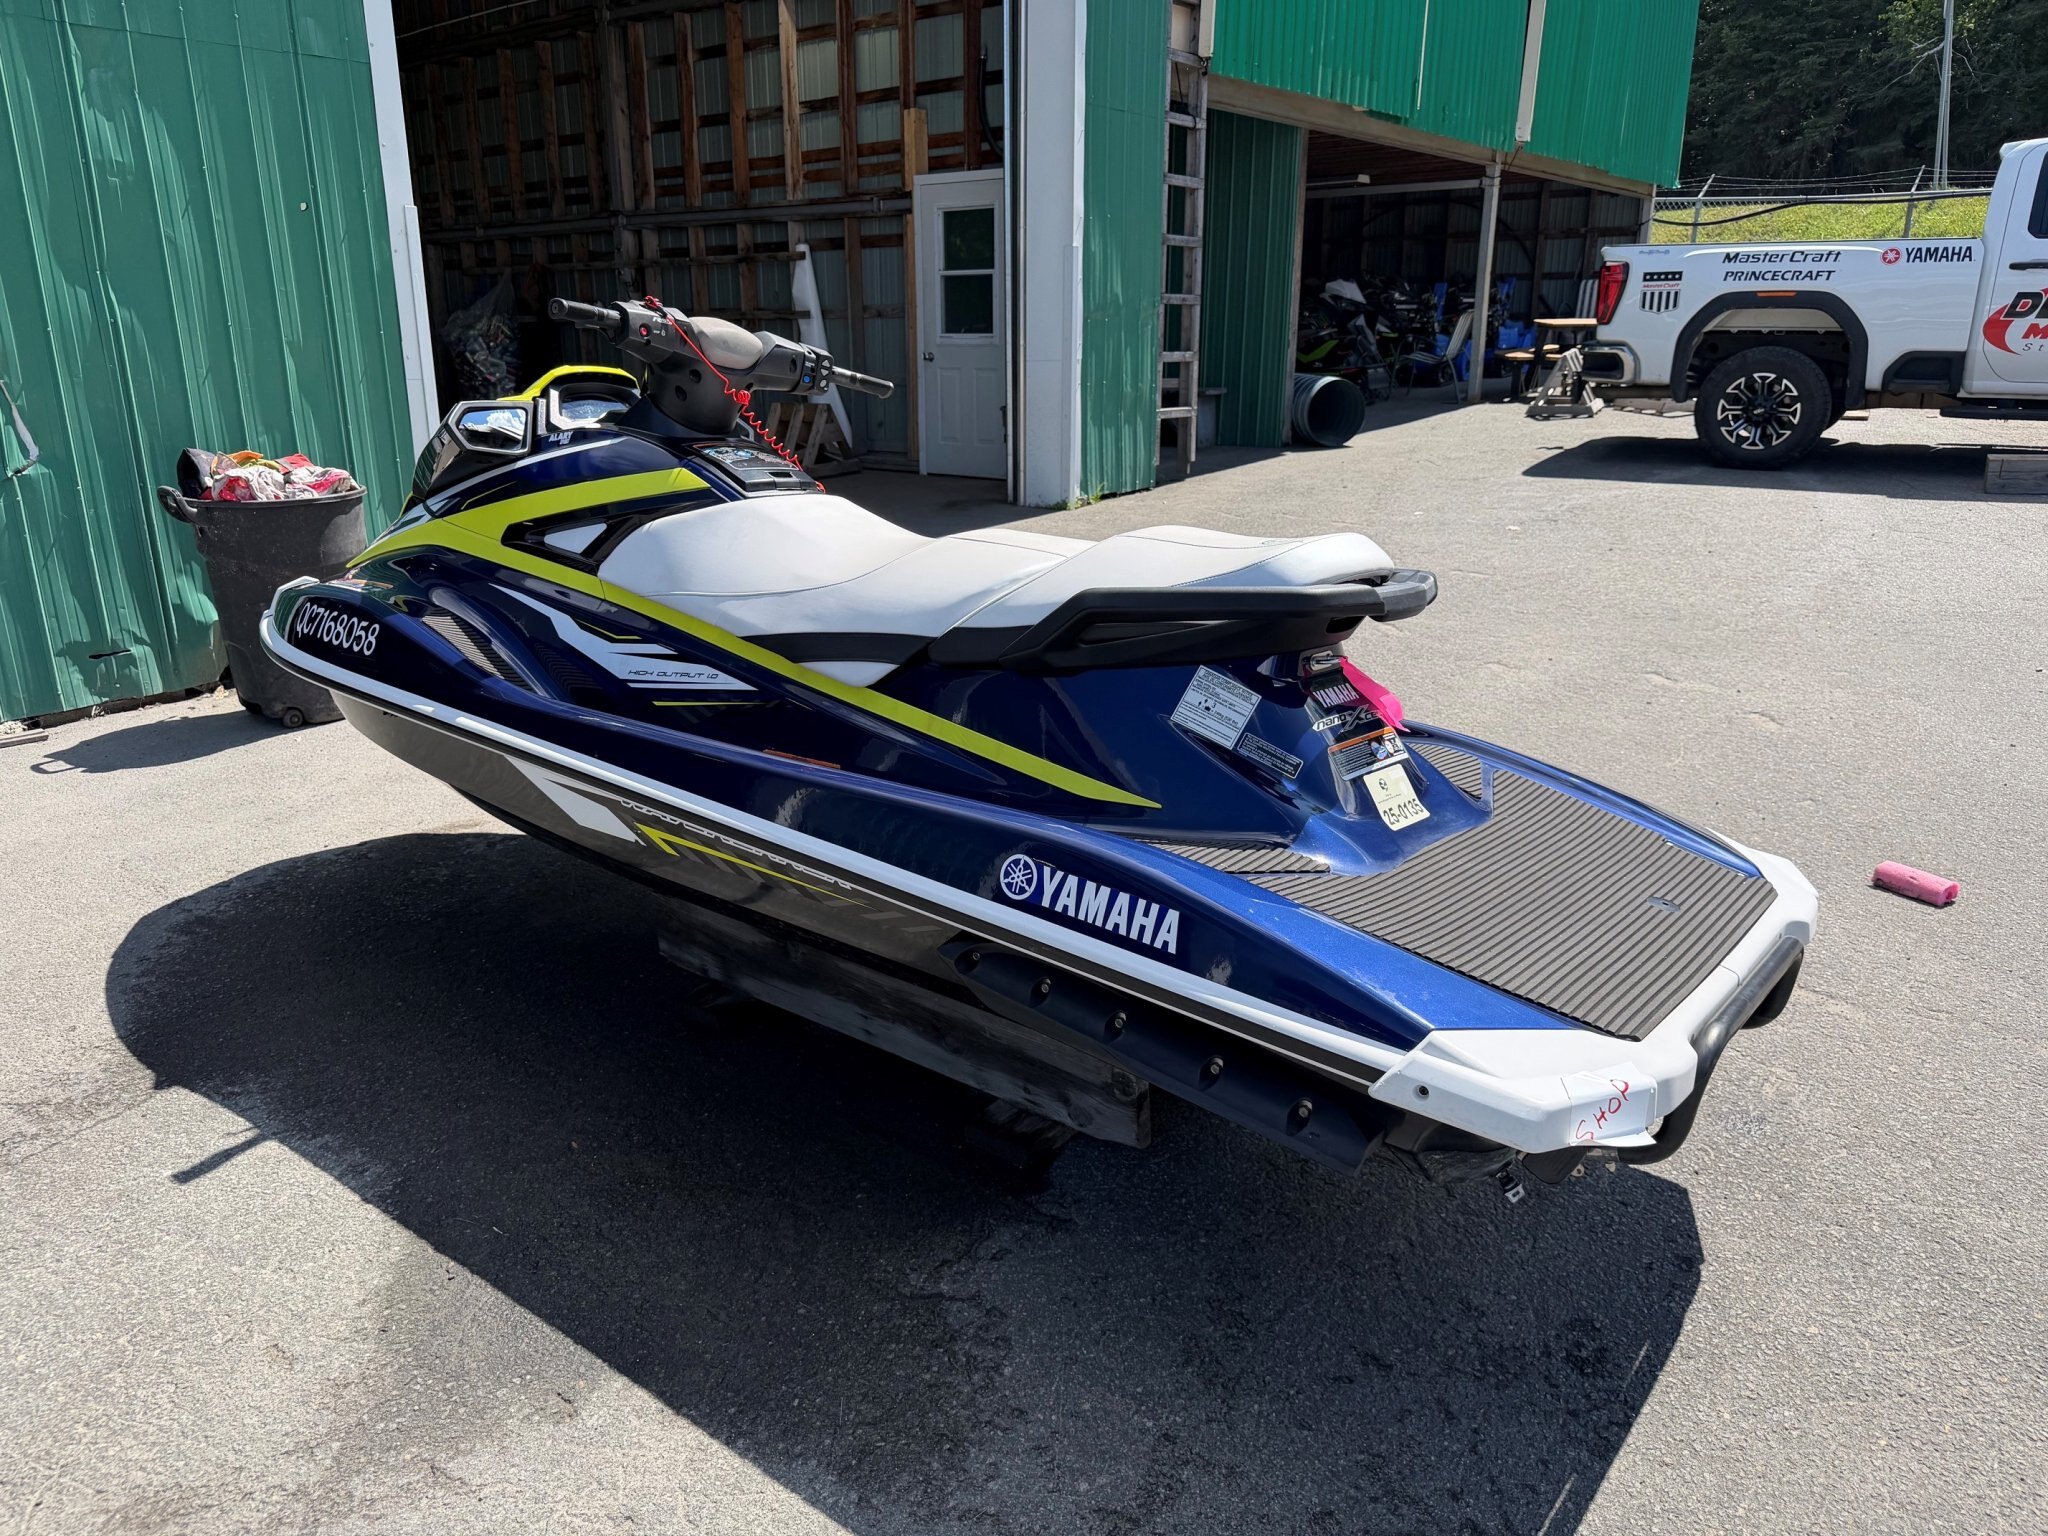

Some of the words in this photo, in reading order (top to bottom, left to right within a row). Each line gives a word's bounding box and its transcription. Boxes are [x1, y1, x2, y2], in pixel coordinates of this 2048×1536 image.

[1722, 251, 1842, 264] MasterCraft
[1905, 246, 1973, 263] YAMAHA
[1723, 270, 1836, 282] PRINCECRAFT
[296, 602, 380, 656] QC7168058
[656, 671, 705, 679] OUTPUT
[1313, 683, 1360, 708] YAMAHA
[1383, 798, 1424, 825] 25-0135
[1041, 865, 1180, 955] YAMAHA
[1576, 1079, 1630, 1140] SHOP
